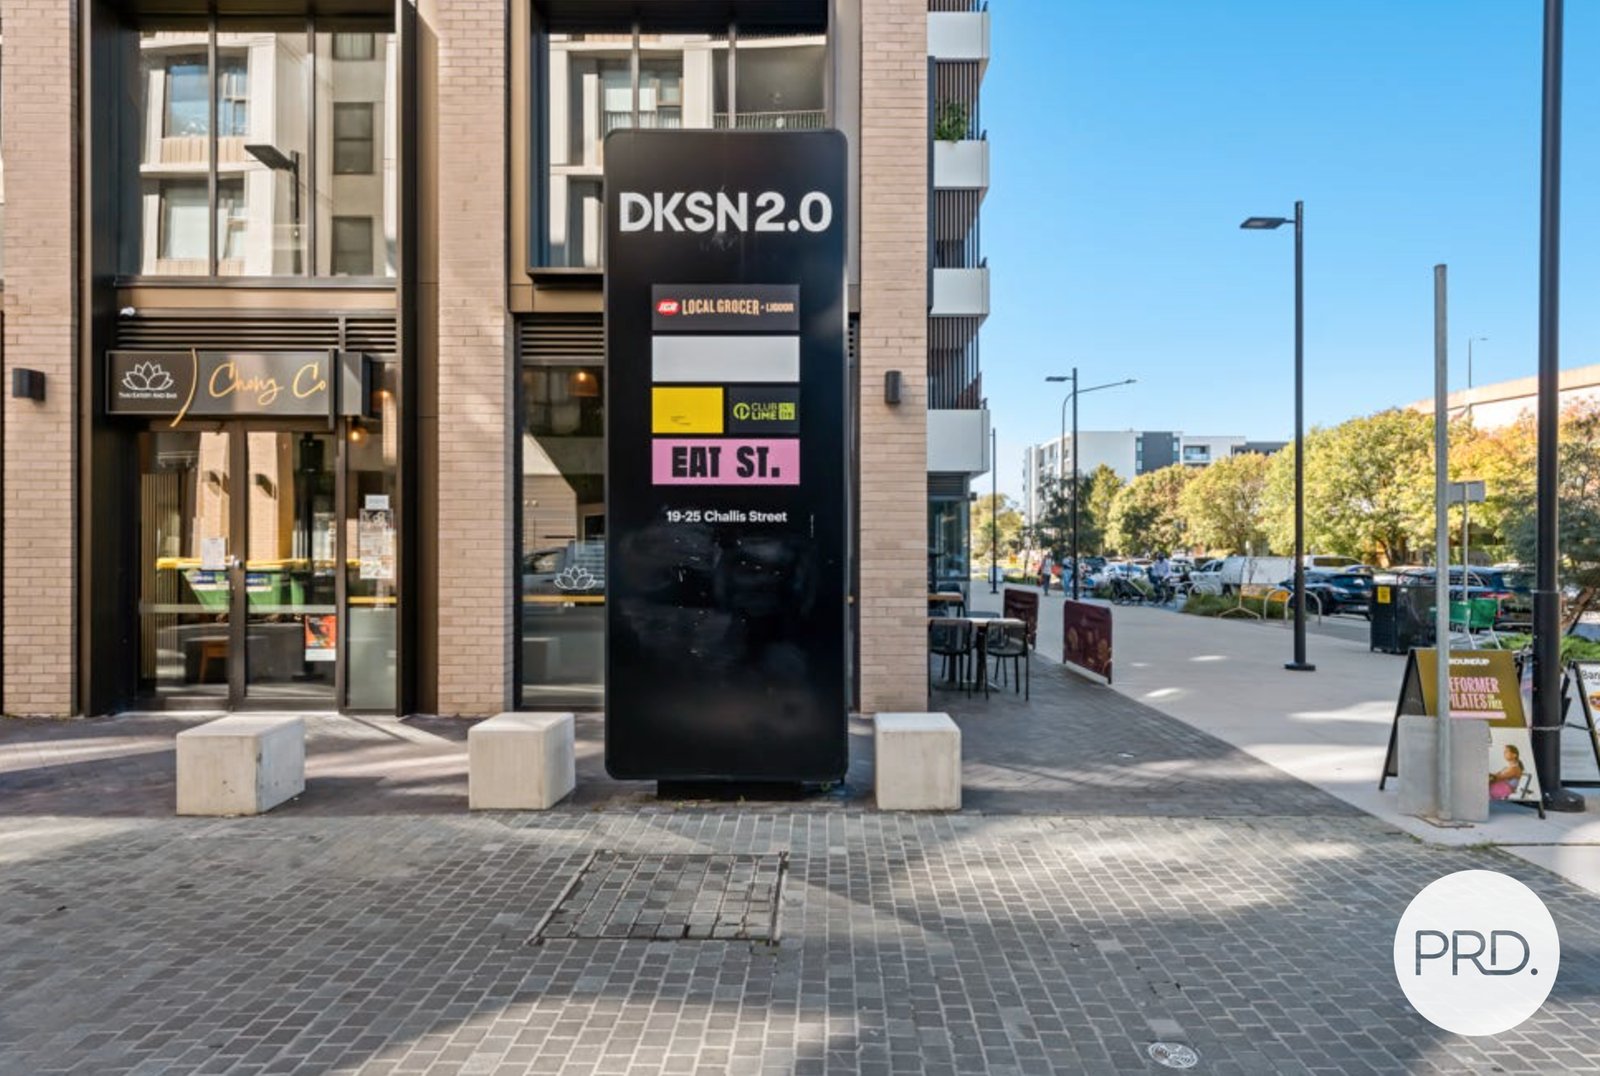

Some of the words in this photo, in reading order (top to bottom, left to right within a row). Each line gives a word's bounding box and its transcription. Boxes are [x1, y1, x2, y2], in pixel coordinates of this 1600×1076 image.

[619, 191, 748, 232] DKSN
[754, 191, 833, 232] 2.0
[682, 299, 716, 315] LOCAL
[717, 299, 760, 315] GROCER
[208, 361, 284, 406] Chong
[293, 361, 327, 398] Co
[751, 411, 778, 420] LIME
[672, 446, 722, 478] EAT
[736, 445, 780, 478] ST.
[665, 510, 701, 523] 19-25
[704, 510, 747, 523] Challis
[749, 510, 788, 523] Street
[1581, 670, 1600, 680] Bar
[1449, 677, 1500, 693] EFORMER
[1449, 693, 1488, 709] ILATES
